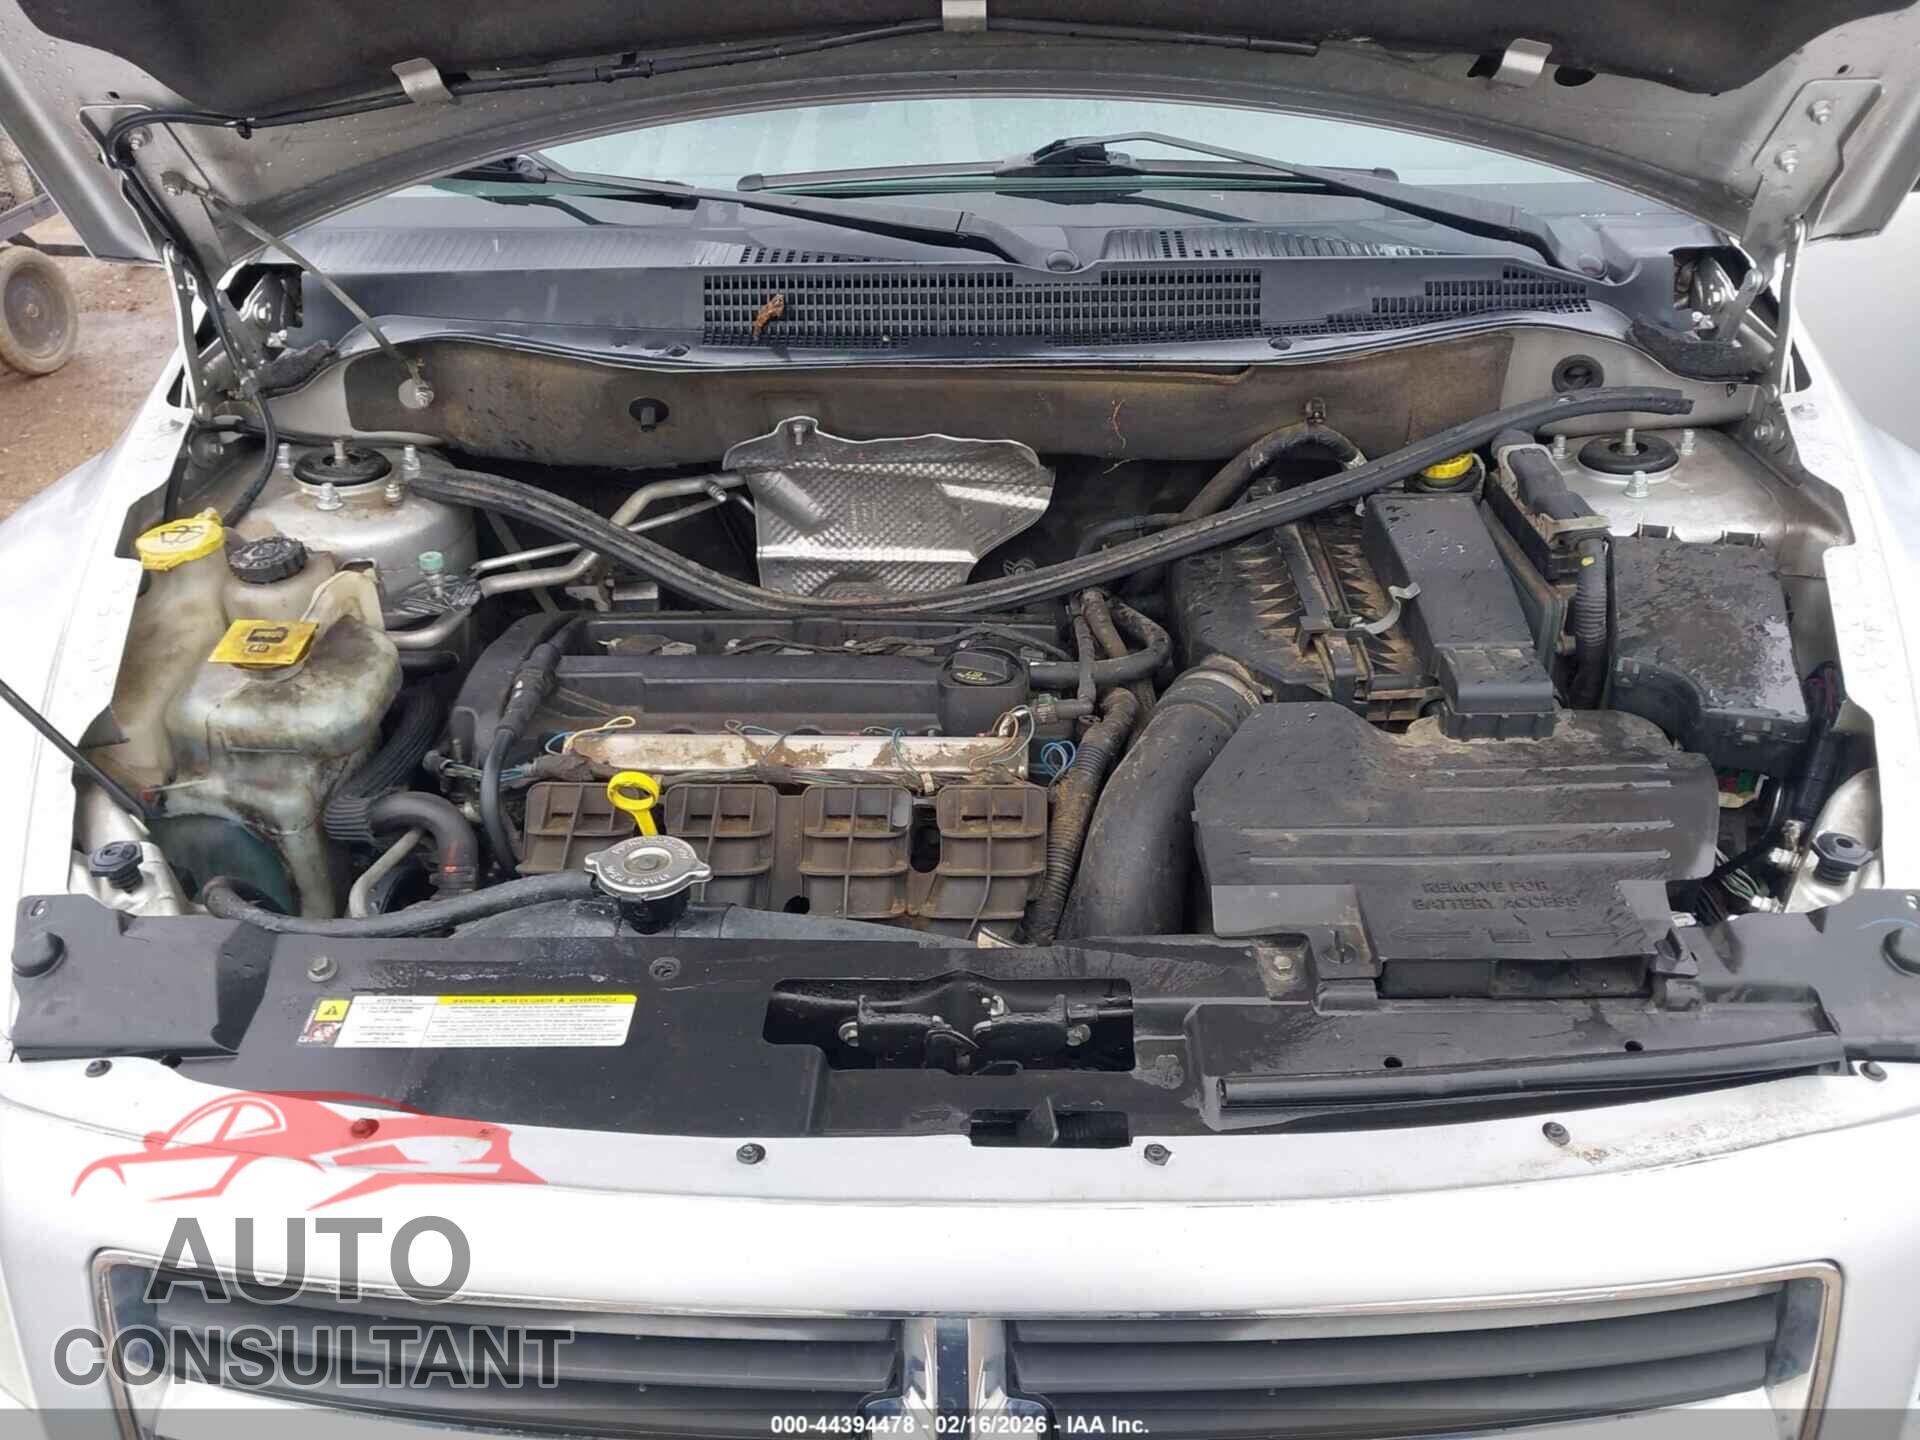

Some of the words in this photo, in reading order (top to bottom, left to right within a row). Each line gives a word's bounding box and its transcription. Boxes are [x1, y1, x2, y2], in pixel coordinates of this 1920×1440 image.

[1422, 881, 1505, 894] REMOVE
[1508, 880, 1549, 893] FOR
[1411, 897, 1495, 911] BATTERY
